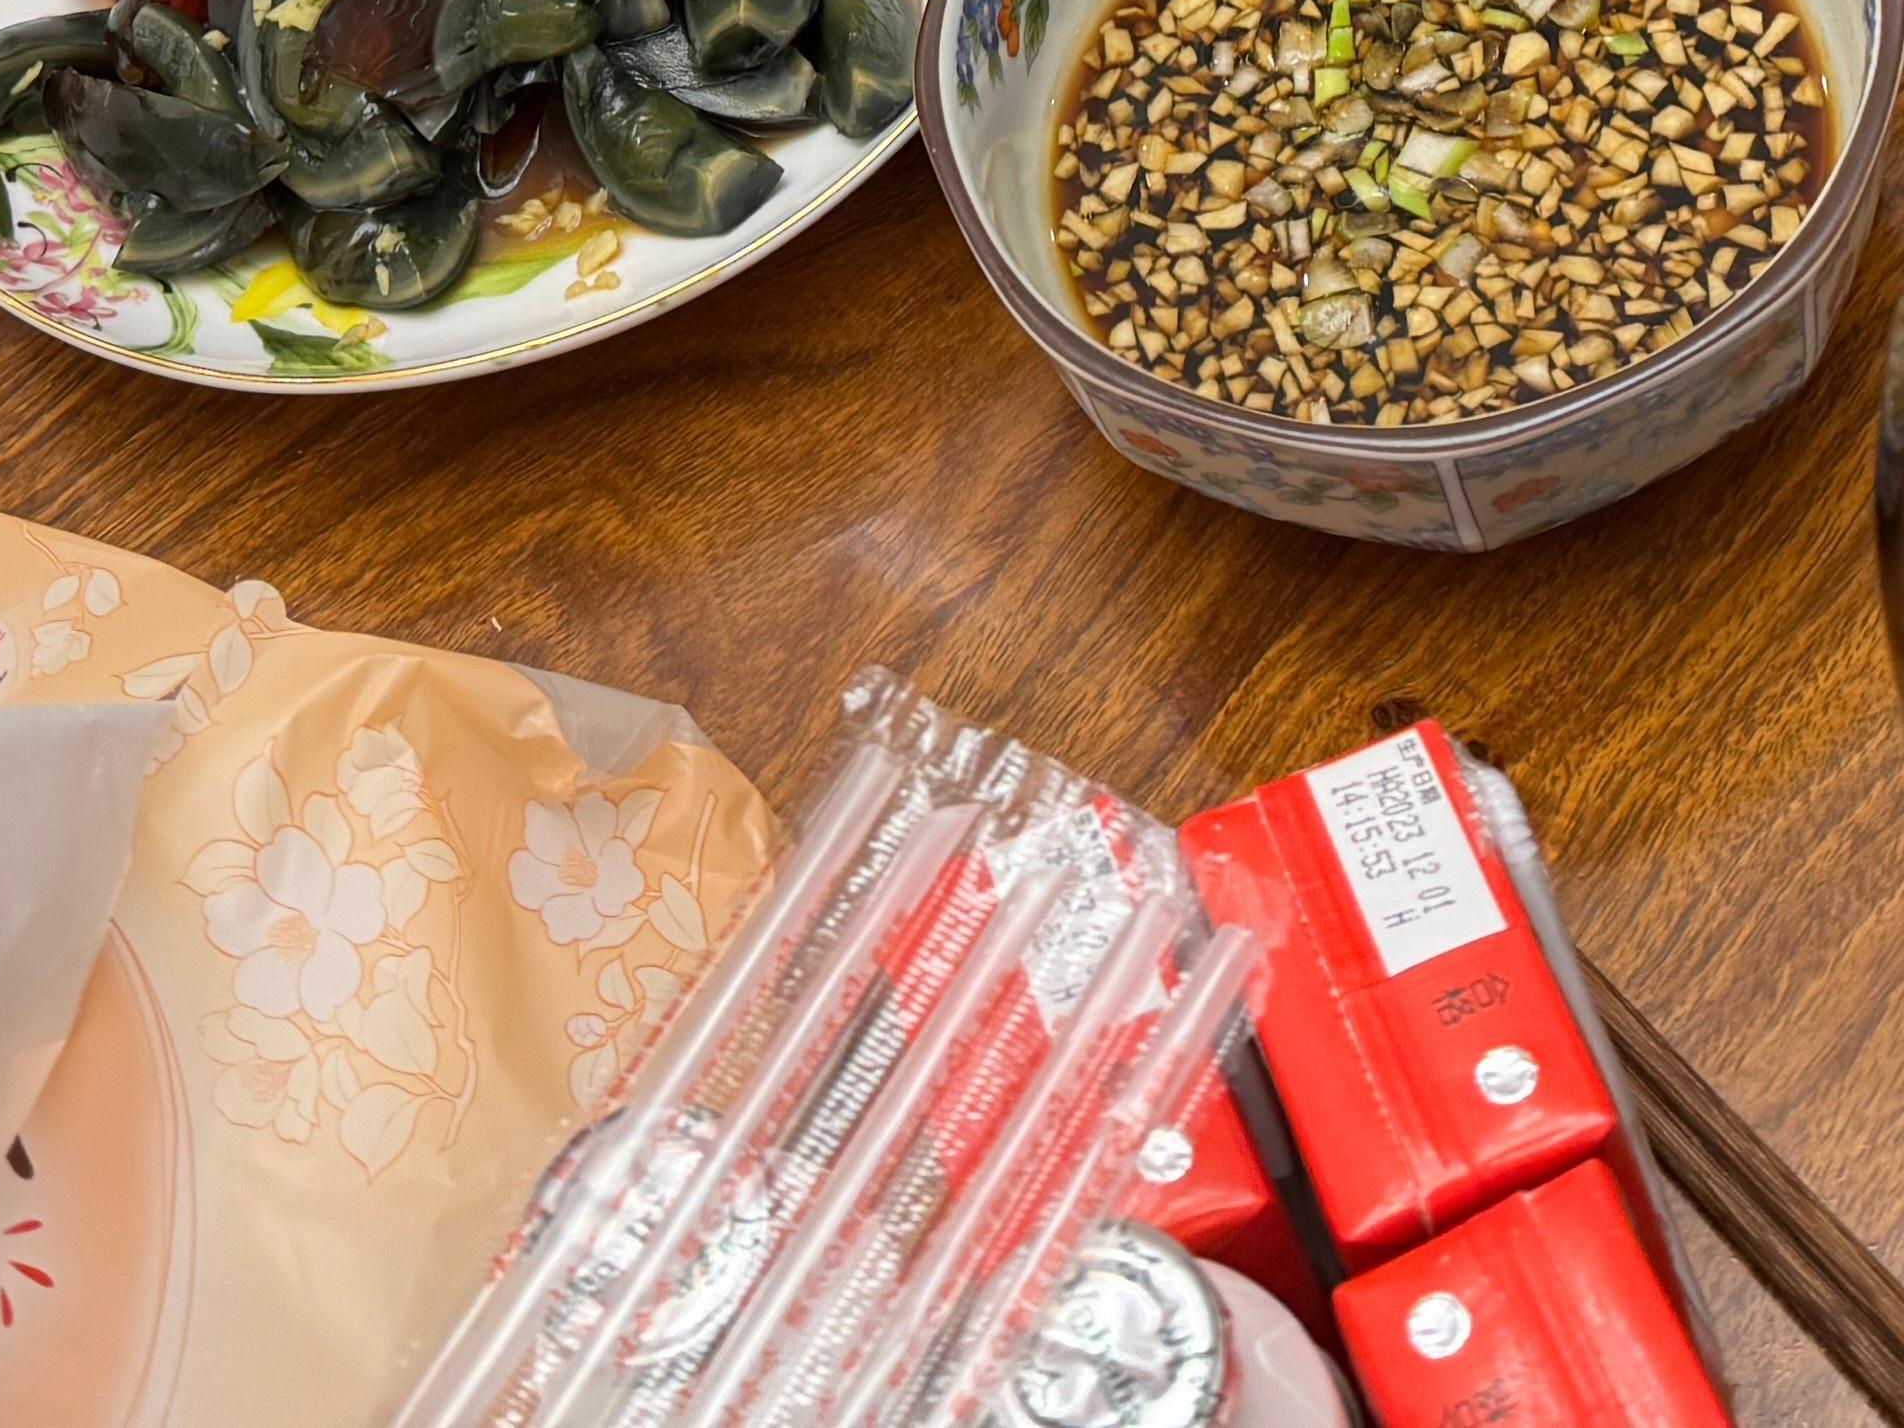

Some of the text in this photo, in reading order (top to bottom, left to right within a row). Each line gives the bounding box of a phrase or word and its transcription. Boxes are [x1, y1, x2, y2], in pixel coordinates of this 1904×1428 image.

[1397, 737, 1443, 806] 生产日期
[1331, 779, 1397, 882] 14:15:53
[1401, 850, 1442, 881] 12
[1417, 884, 1457, 916] 01
[1431, 972, 1511, 1027] 合格
